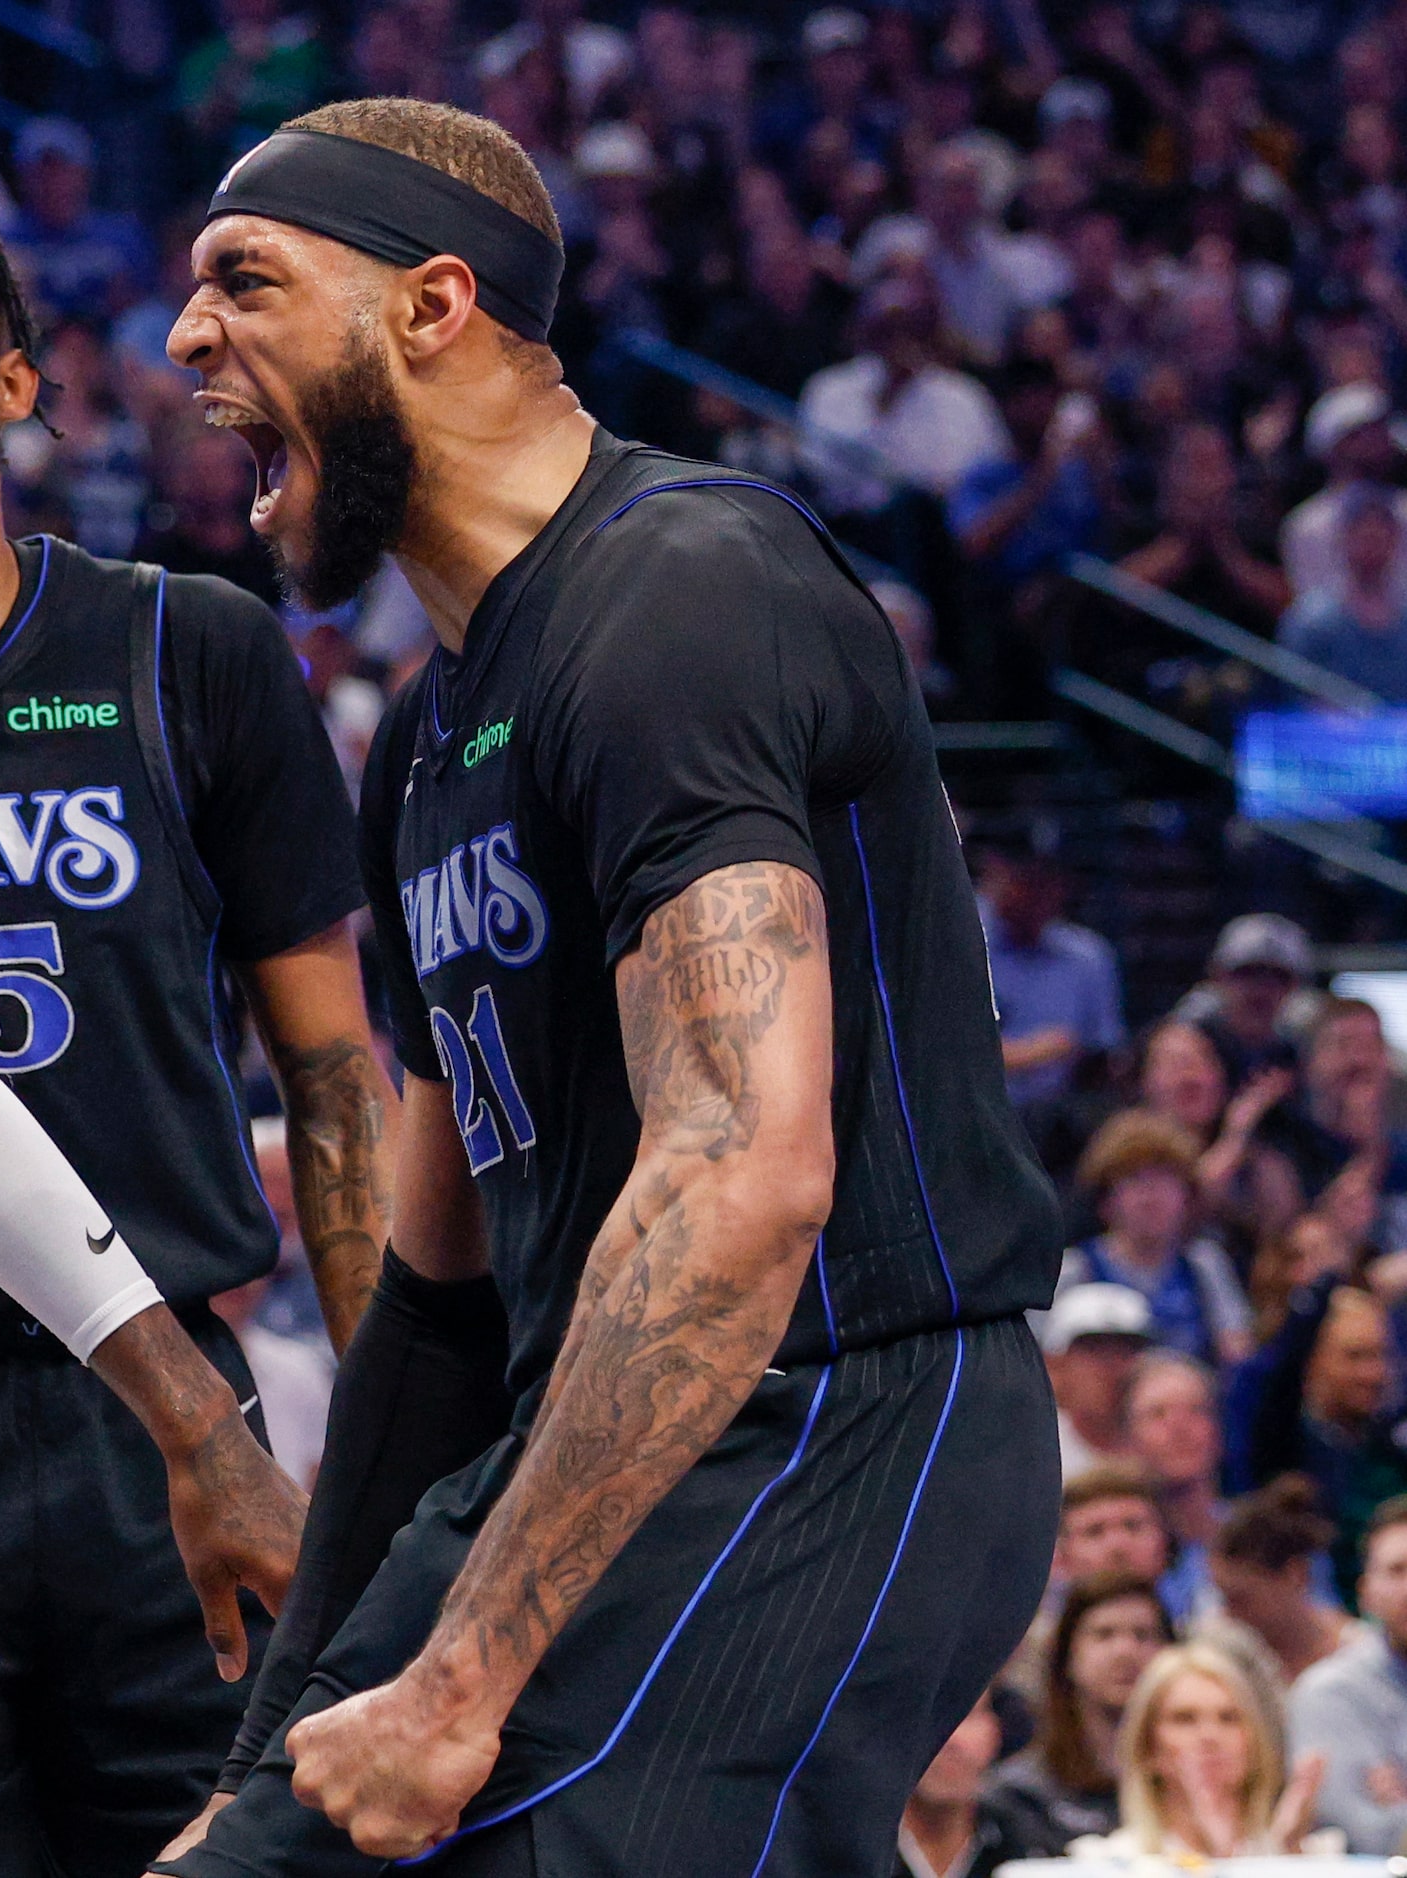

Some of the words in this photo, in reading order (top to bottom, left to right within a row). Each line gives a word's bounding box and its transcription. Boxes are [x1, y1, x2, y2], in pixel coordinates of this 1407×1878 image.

[6, 696, 121, 733] chime
[462, 715, 515, 768] chime
[430, 984, 537, 1178] 21
